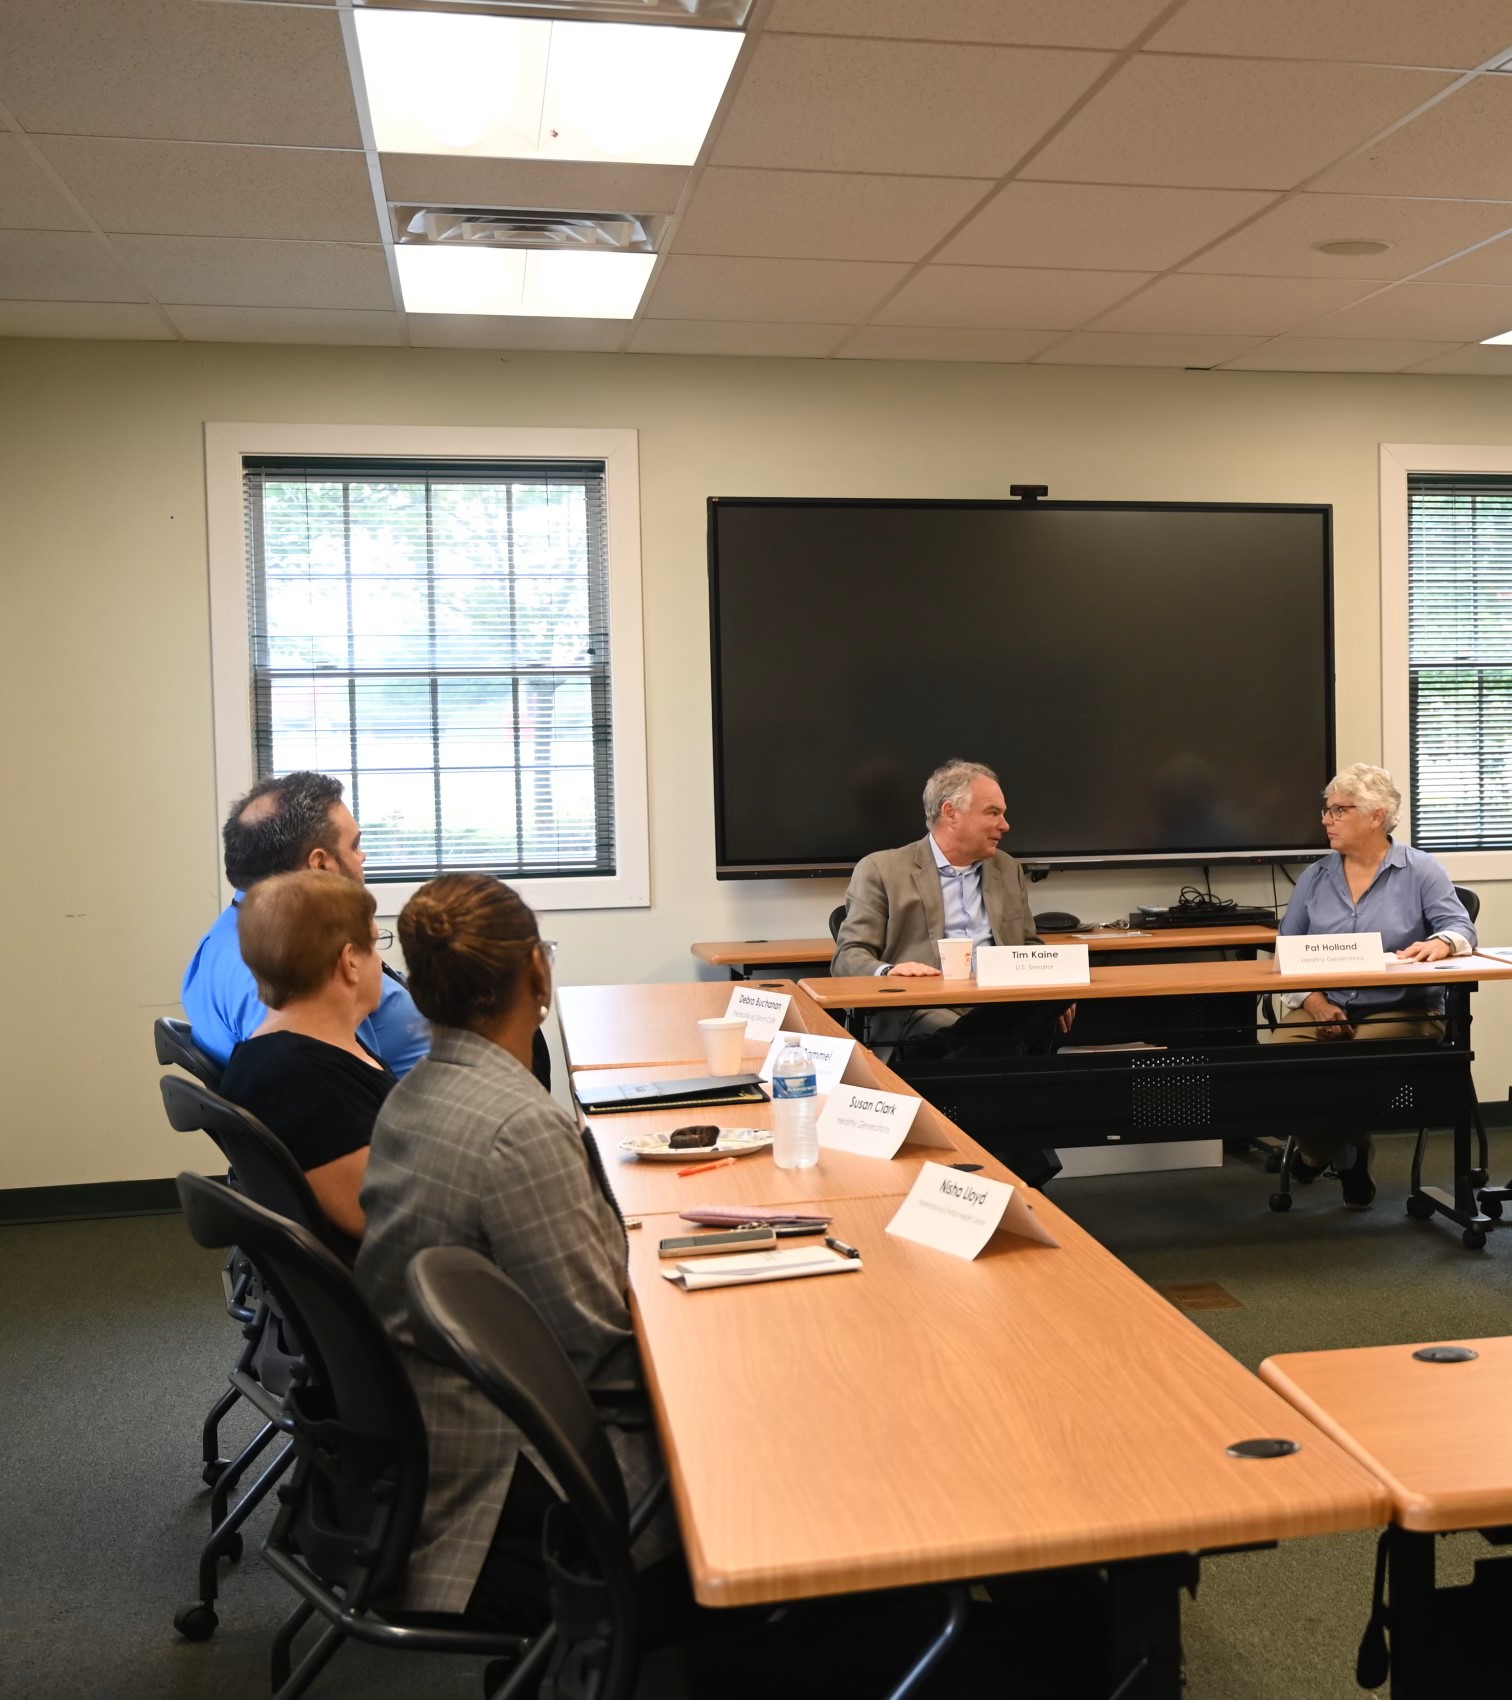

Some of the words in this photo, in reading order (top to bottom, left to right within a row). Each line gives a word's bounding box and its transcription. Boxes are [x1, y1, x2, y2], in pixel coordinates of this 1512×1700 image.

[1012, 951, 1028, 959] Tim
[1031, 950, 1059, 959] Kaine
[1305, 944, 1320, 952] Pat
[1322, 942, 1358, 951] Holland
[739, 994, 756, 1005] Debra
[755, 997, 782, 1010] Buchanan
[849, 1096, 874, 1111] Susan
[874, 1100, 897, 1115] Clark
[939, 1179, 963, 1198] Nisha
[963, 1186, 988, 1206] Lloyd
